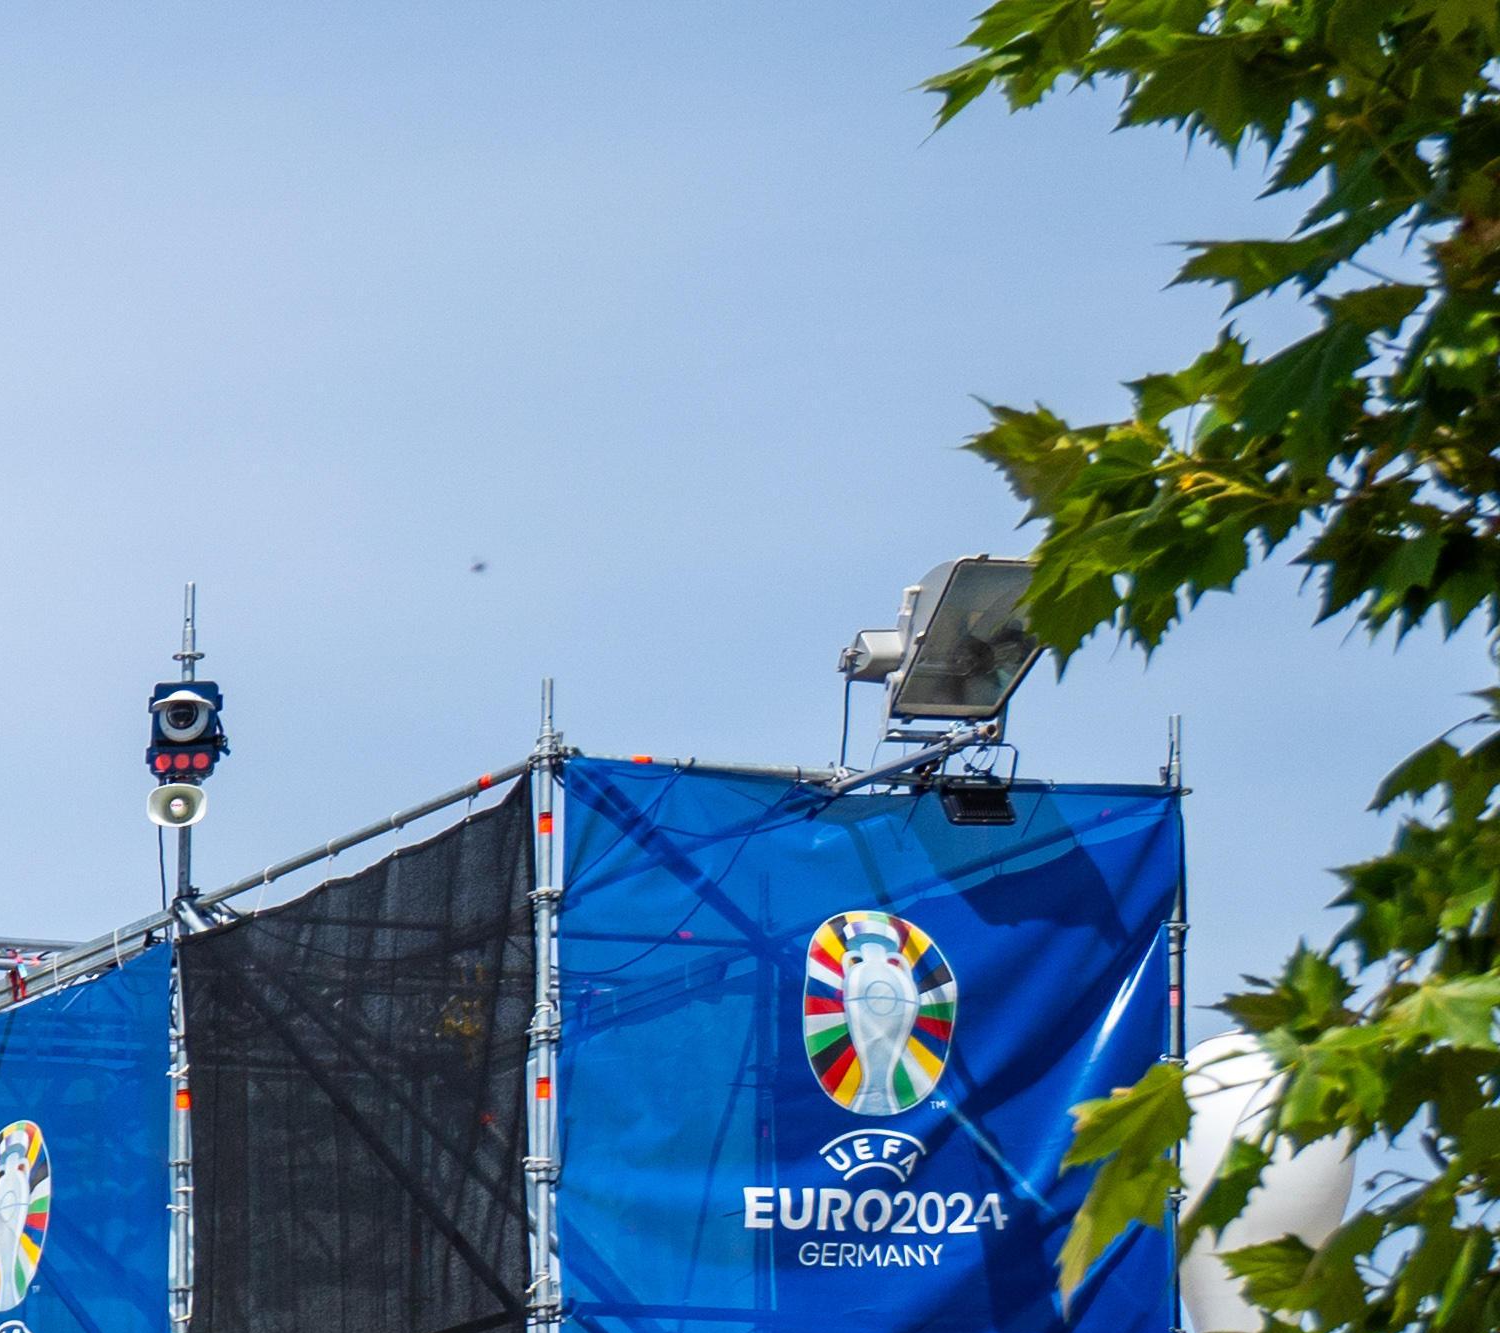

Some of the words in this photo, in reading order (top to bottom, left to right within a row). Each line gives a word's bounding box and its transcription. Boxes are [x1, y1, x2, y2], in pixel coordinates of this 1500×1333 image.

[824, 1137, 919, 1177] UEFA
[743, 1185, 1010, 1234] EURO2024
[799, 1241, 944, 1268] GERMANY
